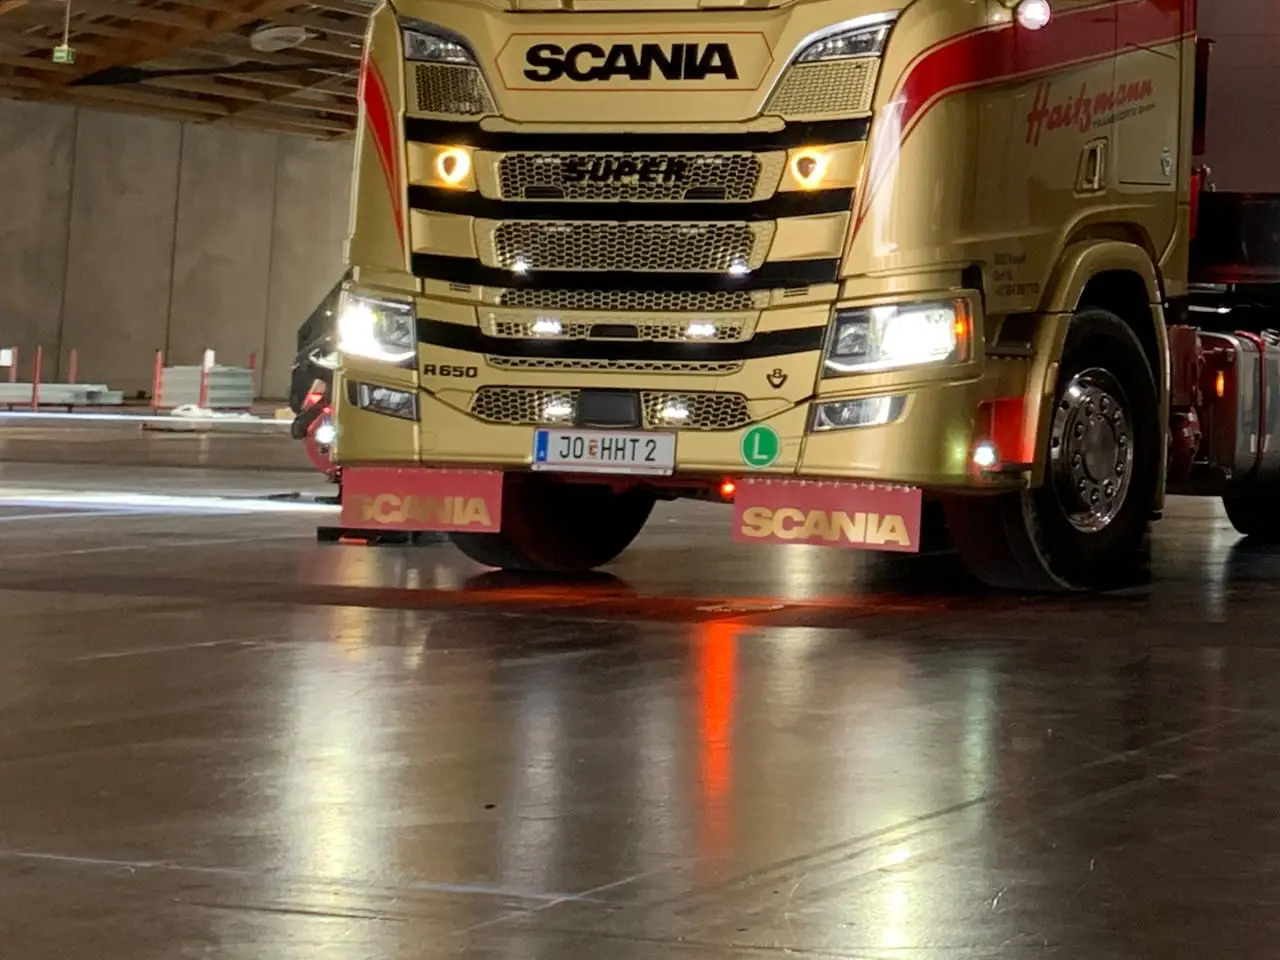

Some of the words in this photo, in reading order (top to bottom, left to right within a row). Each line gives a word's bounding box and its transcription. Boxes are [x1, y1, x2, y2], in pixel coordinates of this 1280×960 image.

[523, 43, 739, 82] SCANIA
[563, 156, 688, 183] SUPER
[424, 364, 436, 376] R
[439, 365, 478, 378] 650
[559, 436, 585, 459] JO
[600, 437, 640, 461] HHT
[644, 439, 657, 462] 2
[752, 431, 768, 460] L
[350, 493, 492, 526] SCANIA
[741, 506, 911, 546] SCANIA
